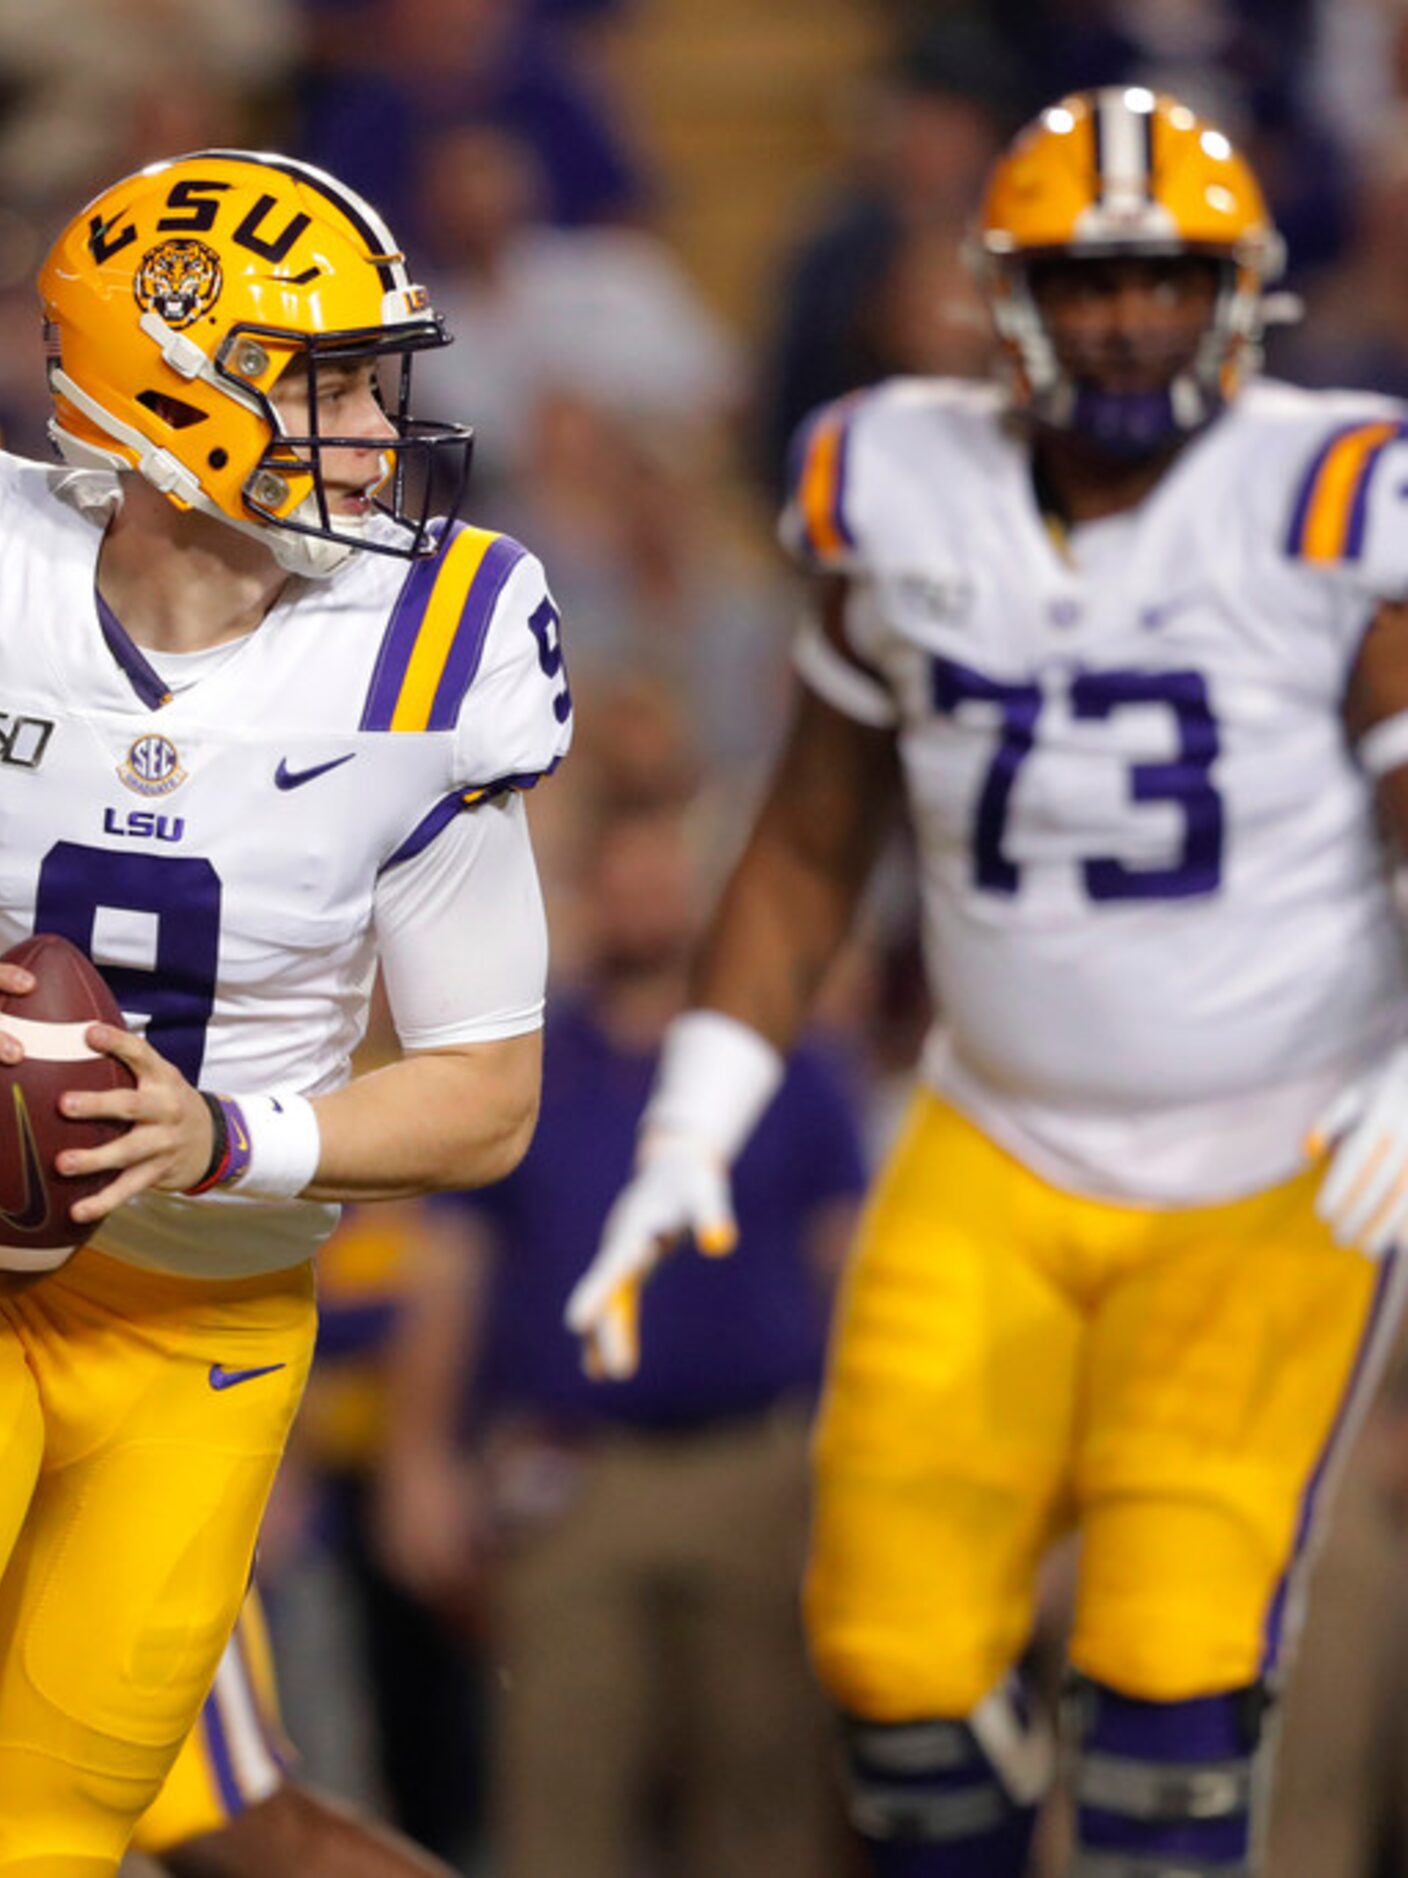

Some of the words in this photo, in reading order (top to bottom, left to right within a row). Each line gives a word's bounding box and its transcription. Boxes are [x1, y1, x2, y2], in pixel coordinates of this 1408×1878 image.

[88, 181, 312, 265] LSU
[133, 738, 175, 779] SEC
[929, 655, 1225, 902] 73
[103, 806, 185, 843] LSU
